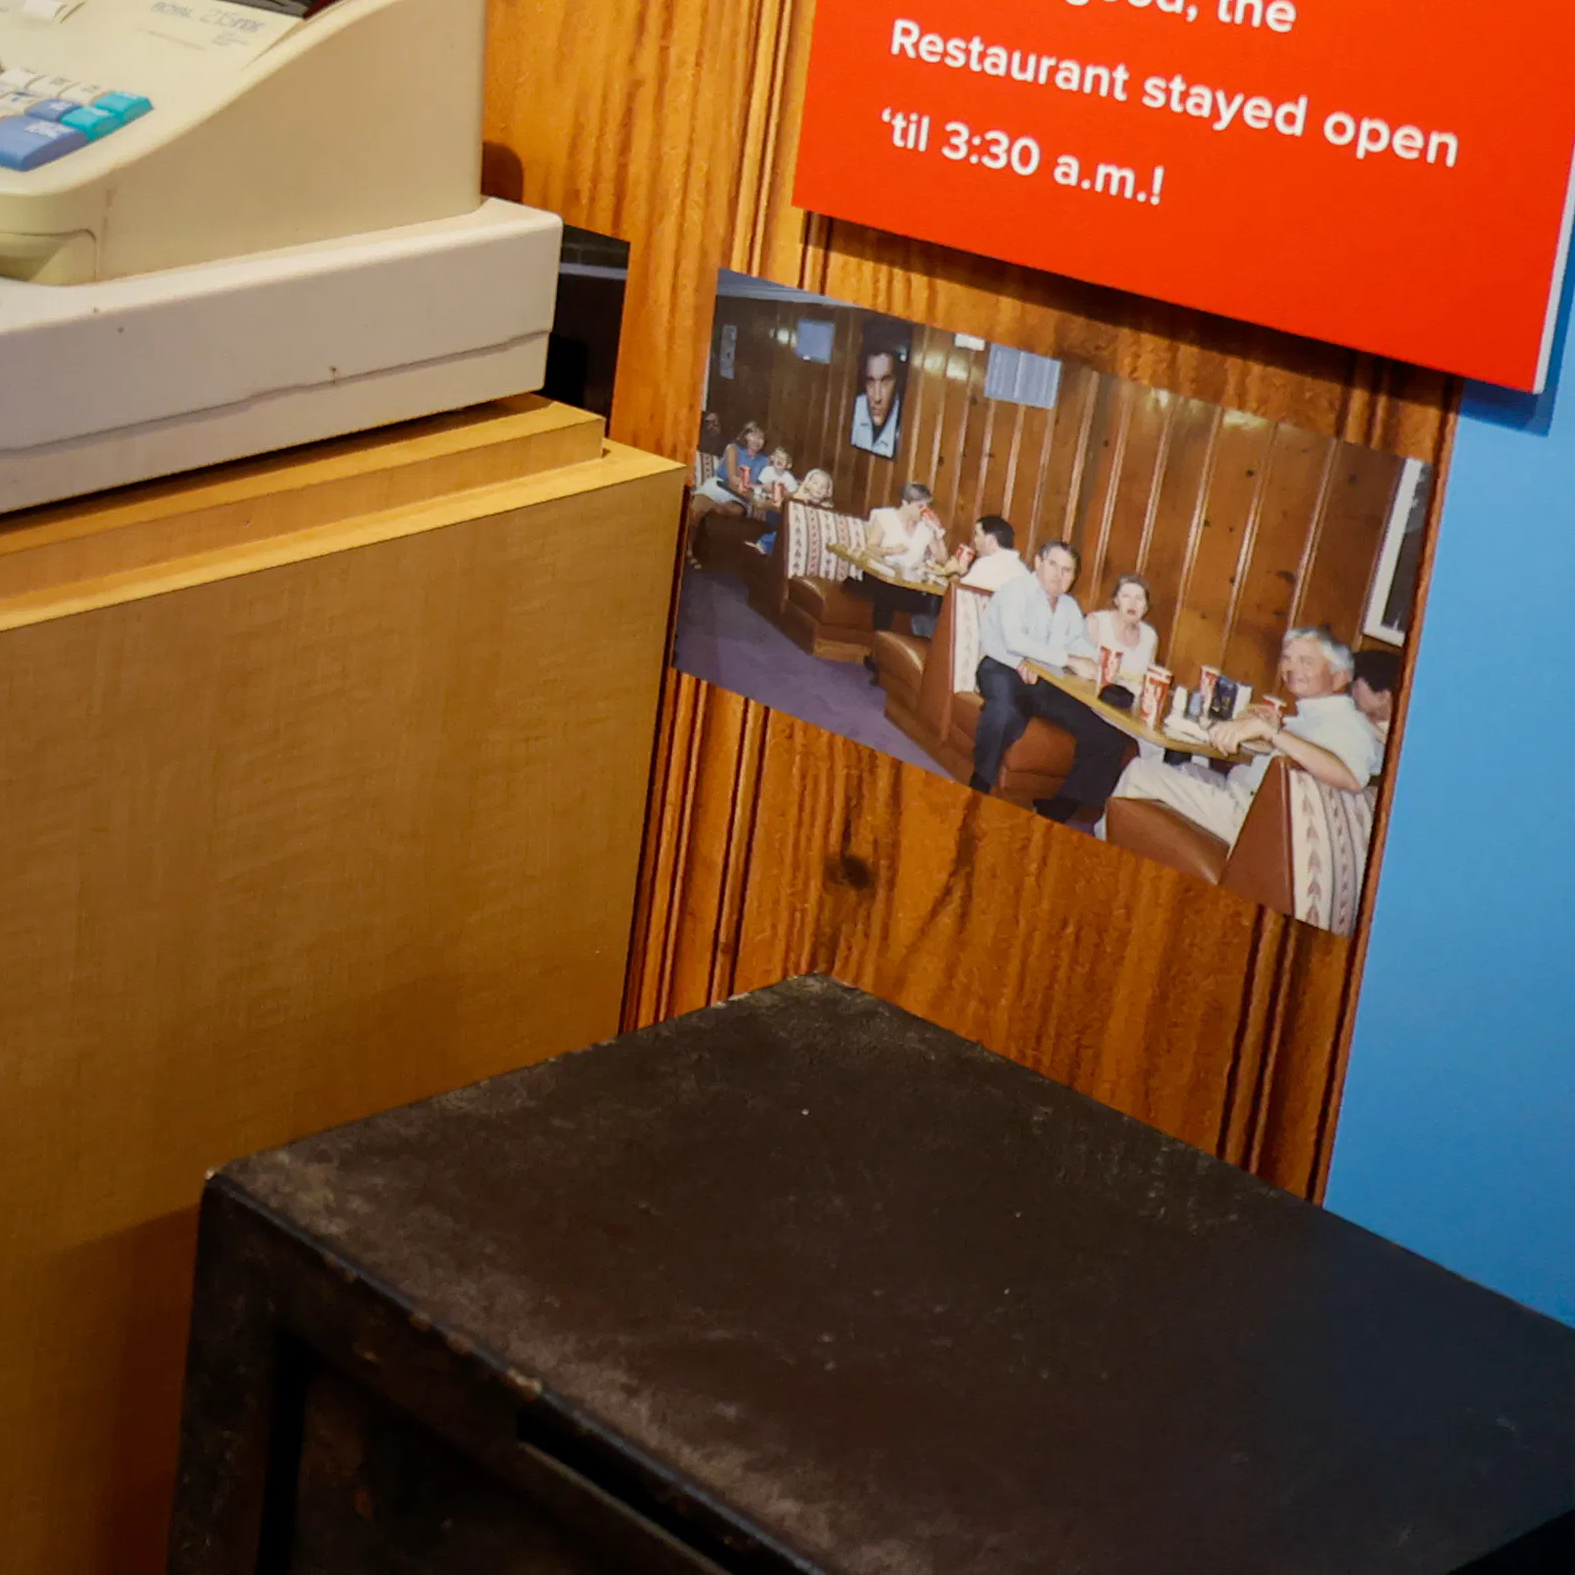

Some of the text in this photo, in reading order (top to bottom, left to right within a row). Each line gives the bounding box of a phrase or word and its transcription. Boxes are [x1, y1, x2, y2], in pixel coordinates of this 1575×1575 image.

[890, 18, 1459, 169] Restaurant stayed open
[941, 118, 1041, 178] 3:30
[1053, 148, 1165, 208] a.m.!
